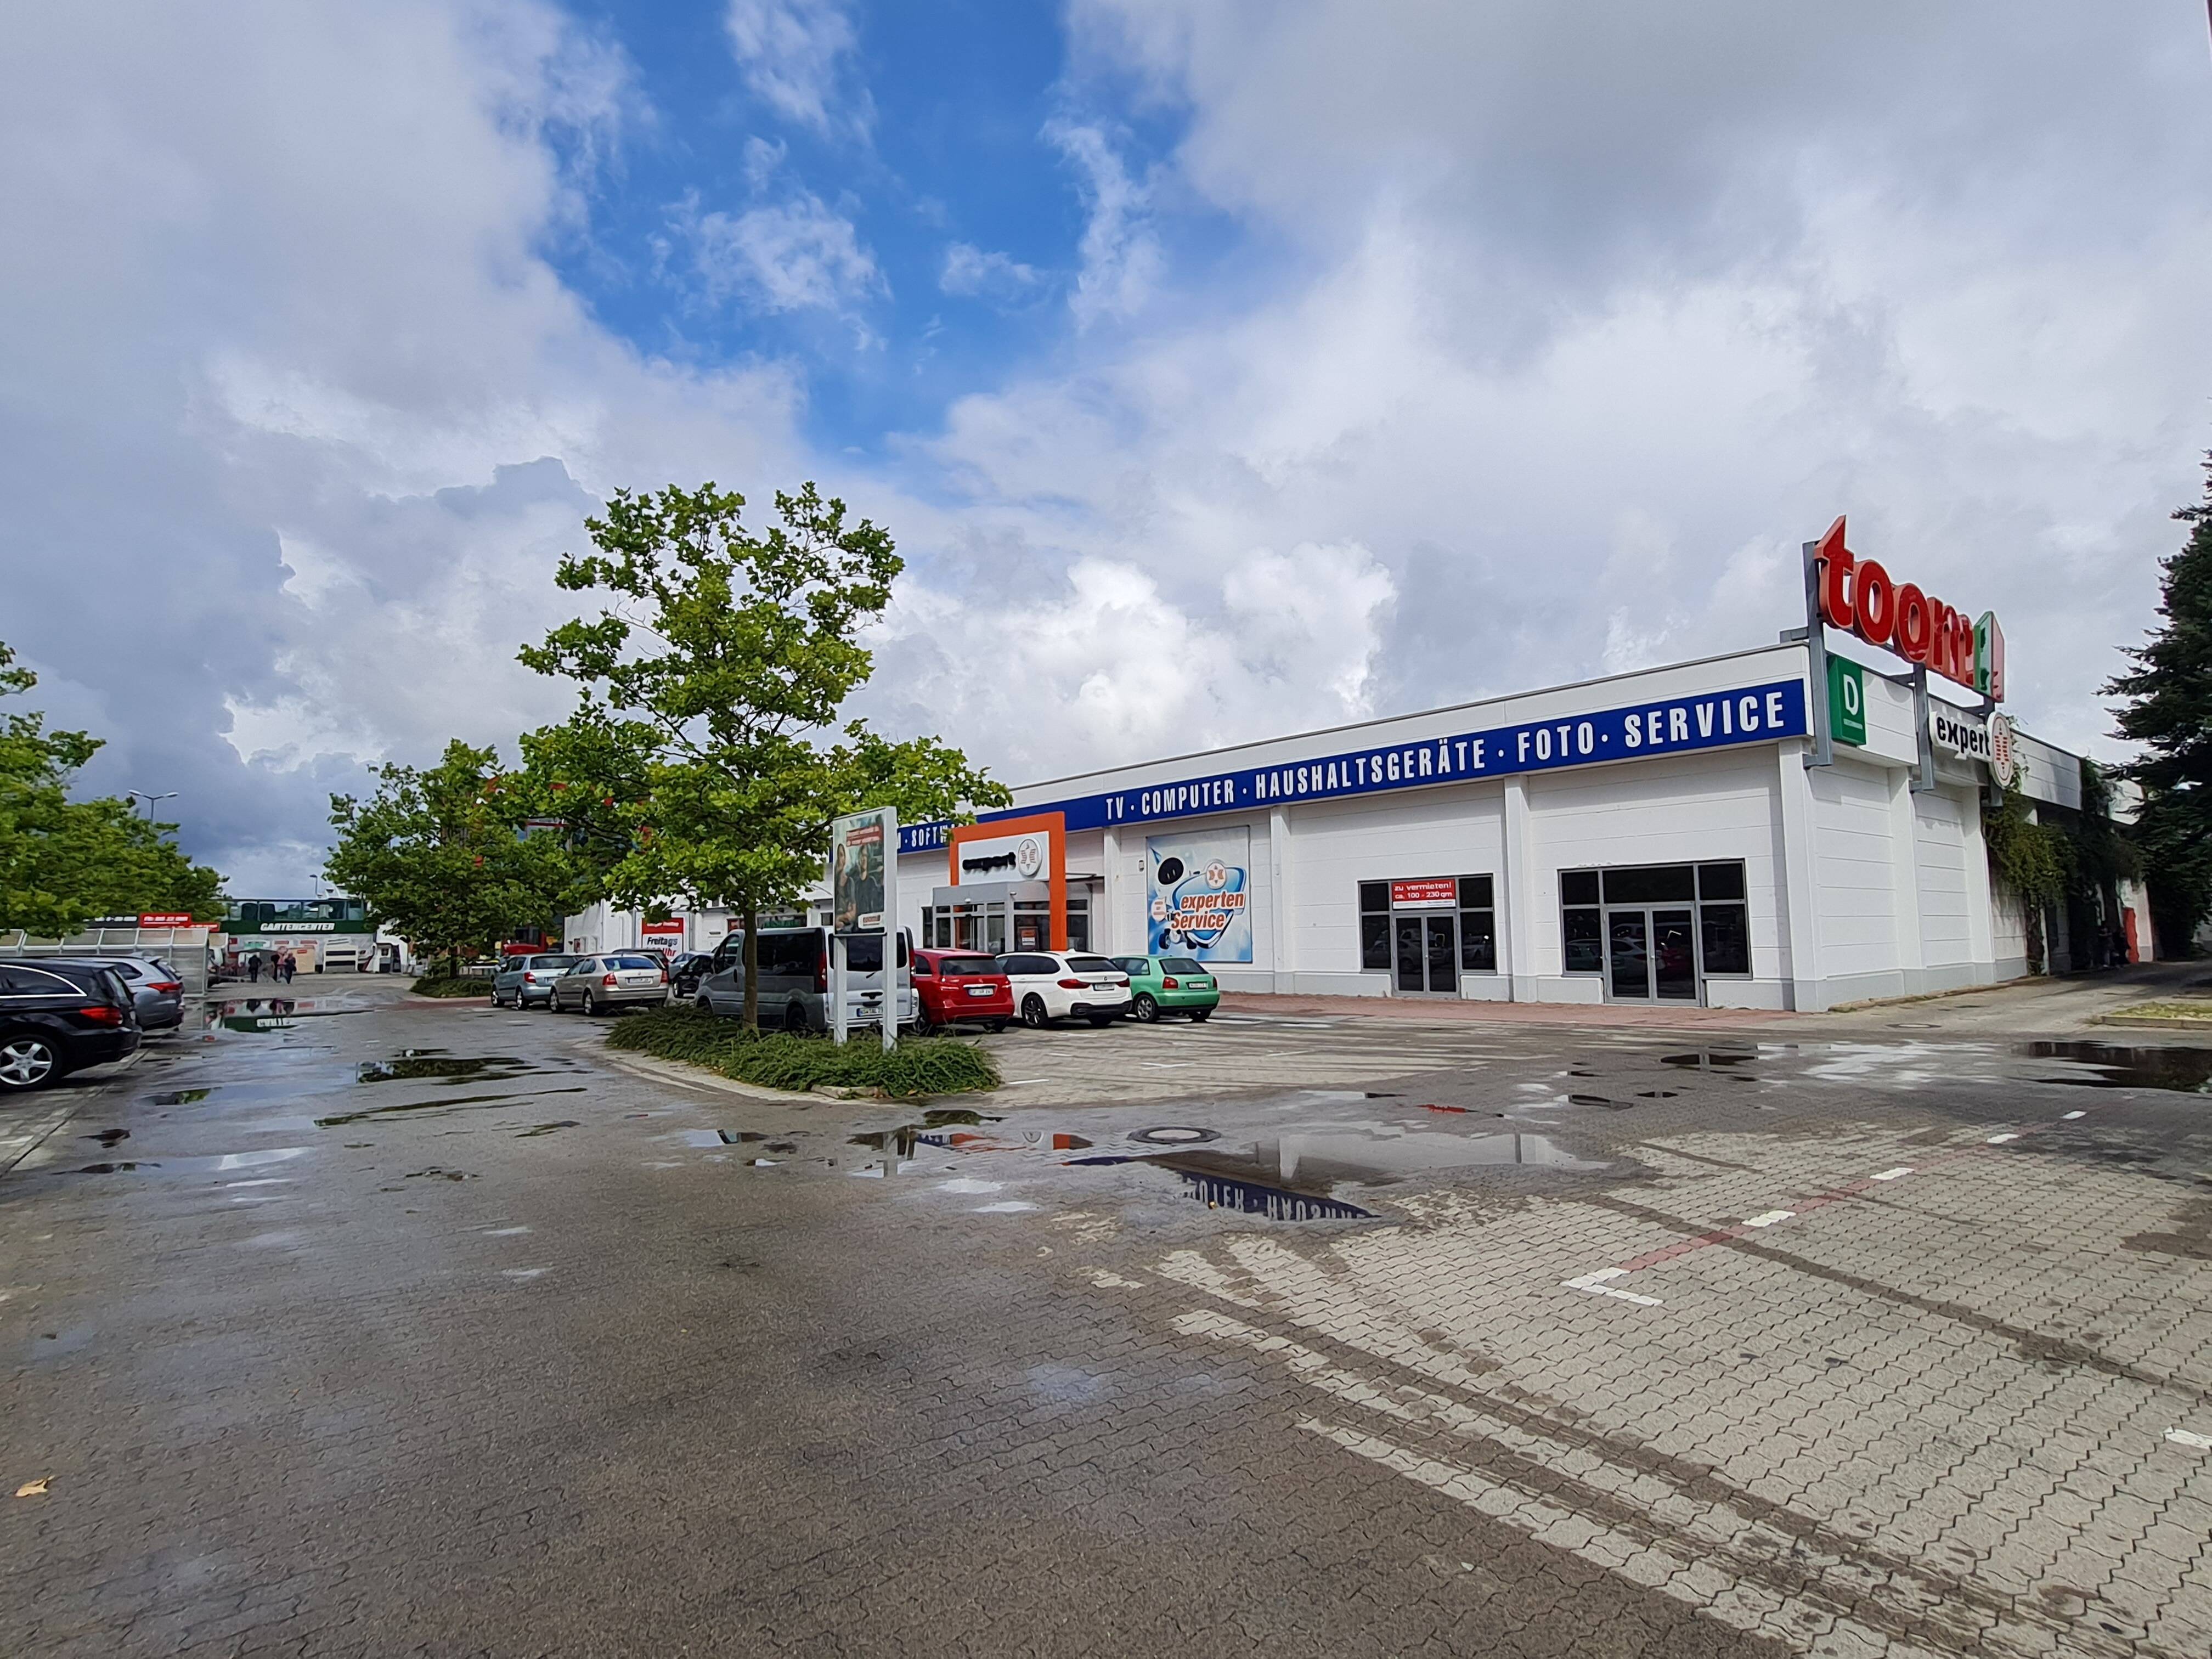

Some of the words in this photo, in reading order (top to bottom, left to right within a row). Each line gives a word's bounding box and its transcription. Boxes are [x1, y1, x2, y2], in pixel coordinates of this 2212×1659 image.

[1937, 717, 1991, 756] expert
[1106, 797, 1124, 820] TV
[1142, 779, 1234, 815] COMPUTER
[1256, 738, 1485, 799] HAUSHALTSGERÄTE
[1517, 722, 1594, 763] FOTO
[1624, 692, 1784, 748] SERVICE
[1406, 882, 1452, 891] vermieten!
[1181, 891, 1244, 912] experten
[1171, 911, 1225, 929] Service
[647, 937, 678, 947] Freitags
